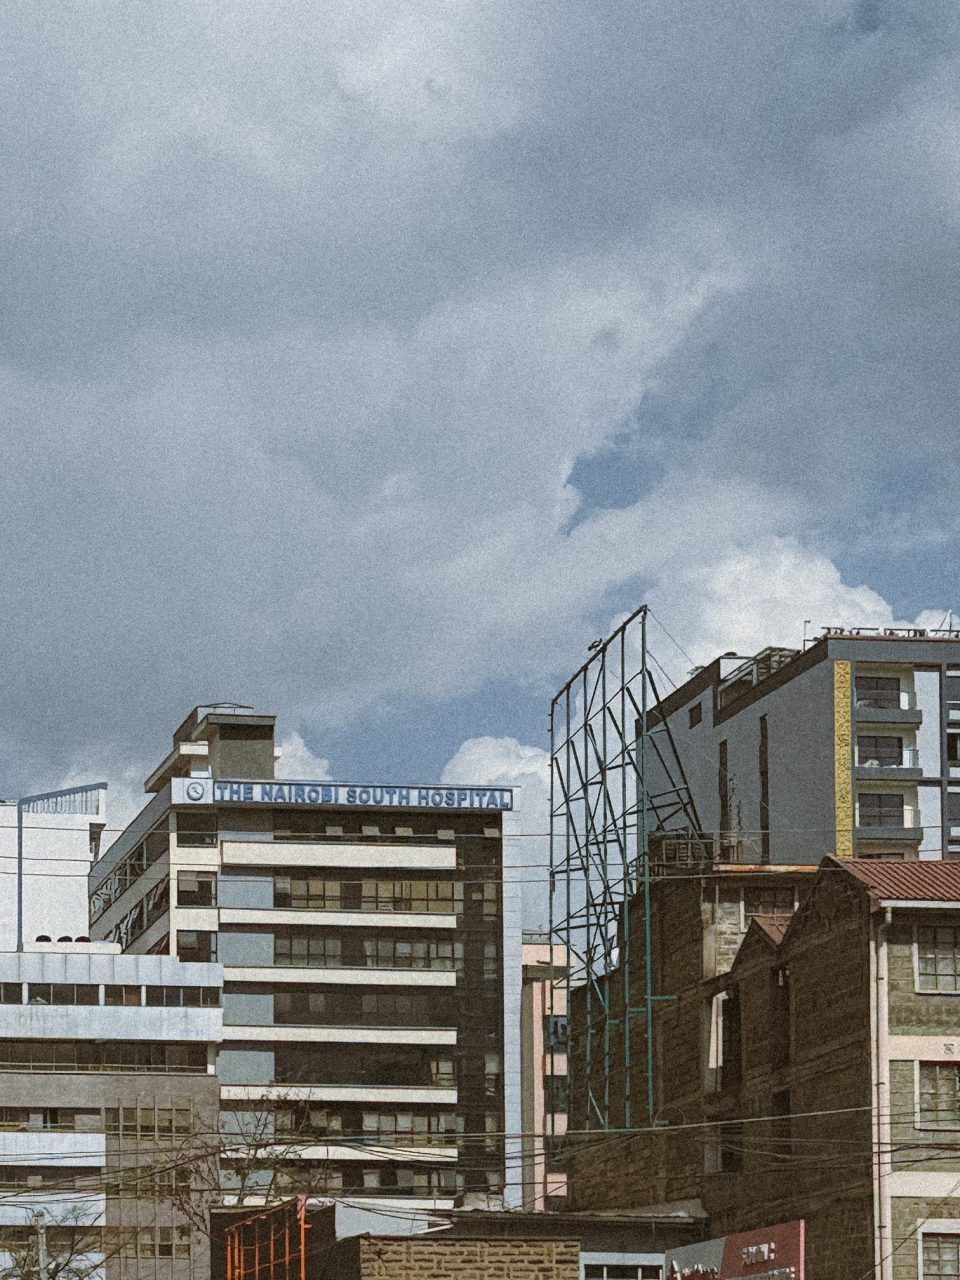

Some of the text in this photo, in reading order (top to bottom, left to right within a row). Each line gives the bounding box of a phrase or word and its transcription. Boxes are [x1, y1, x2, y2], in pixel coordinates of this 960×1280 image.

[217, 783, 511, 809] THE NAIROBI SOUTH HOSPITAL
